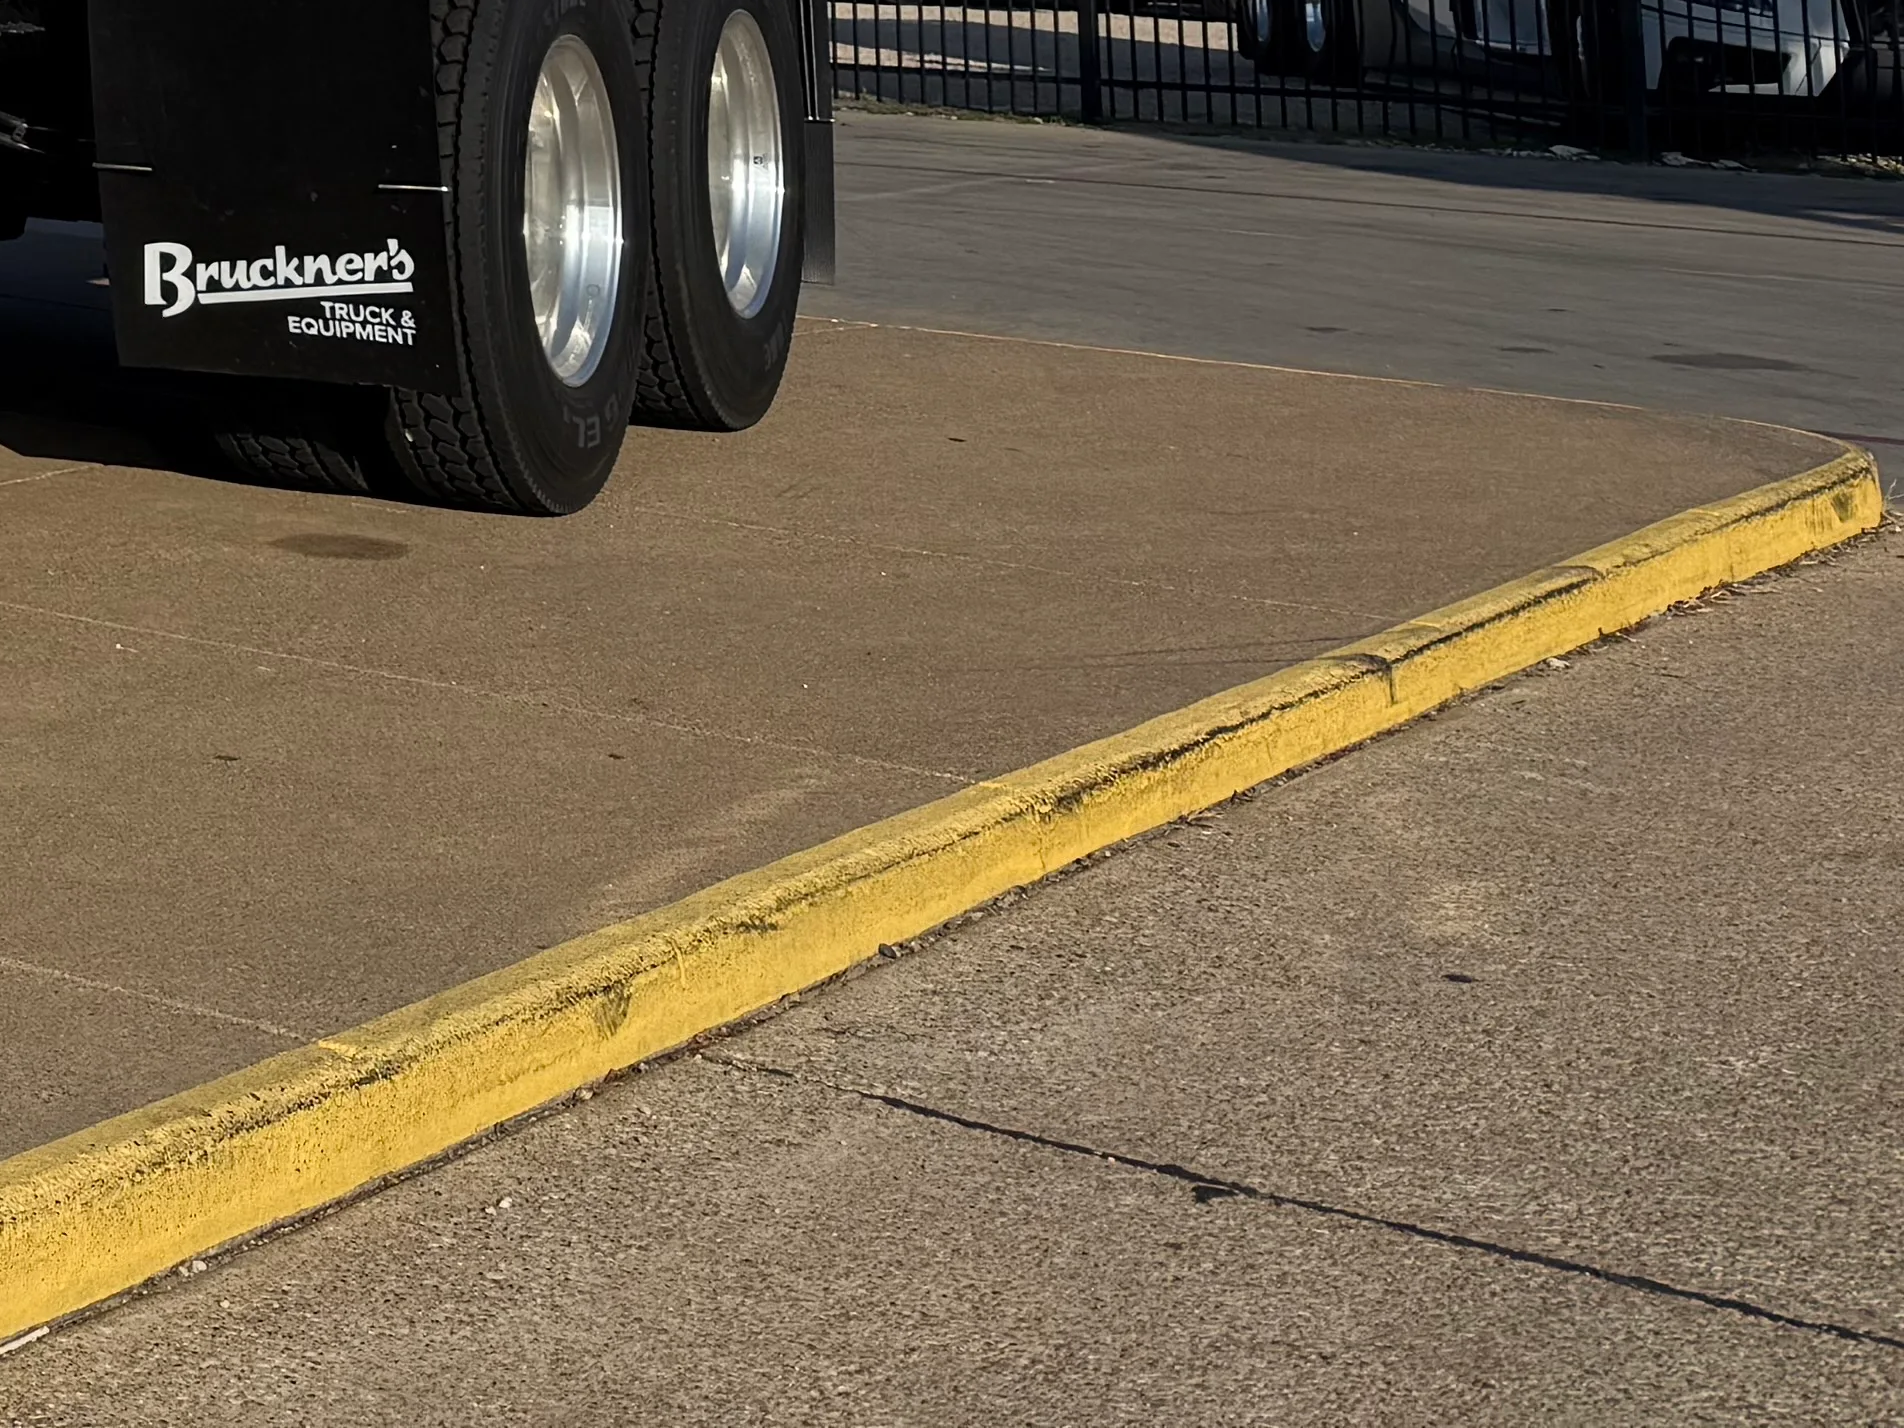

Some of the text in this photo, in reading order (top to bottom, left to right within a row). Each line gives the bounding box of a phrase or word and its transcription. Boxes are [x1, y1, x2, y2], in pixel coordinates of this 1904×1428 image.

[143, 238, 415, 319] Bruckner's
[320, 300, 416, 329] TRUCK &
[287, 315, 417, 346] EQUIPMENT
